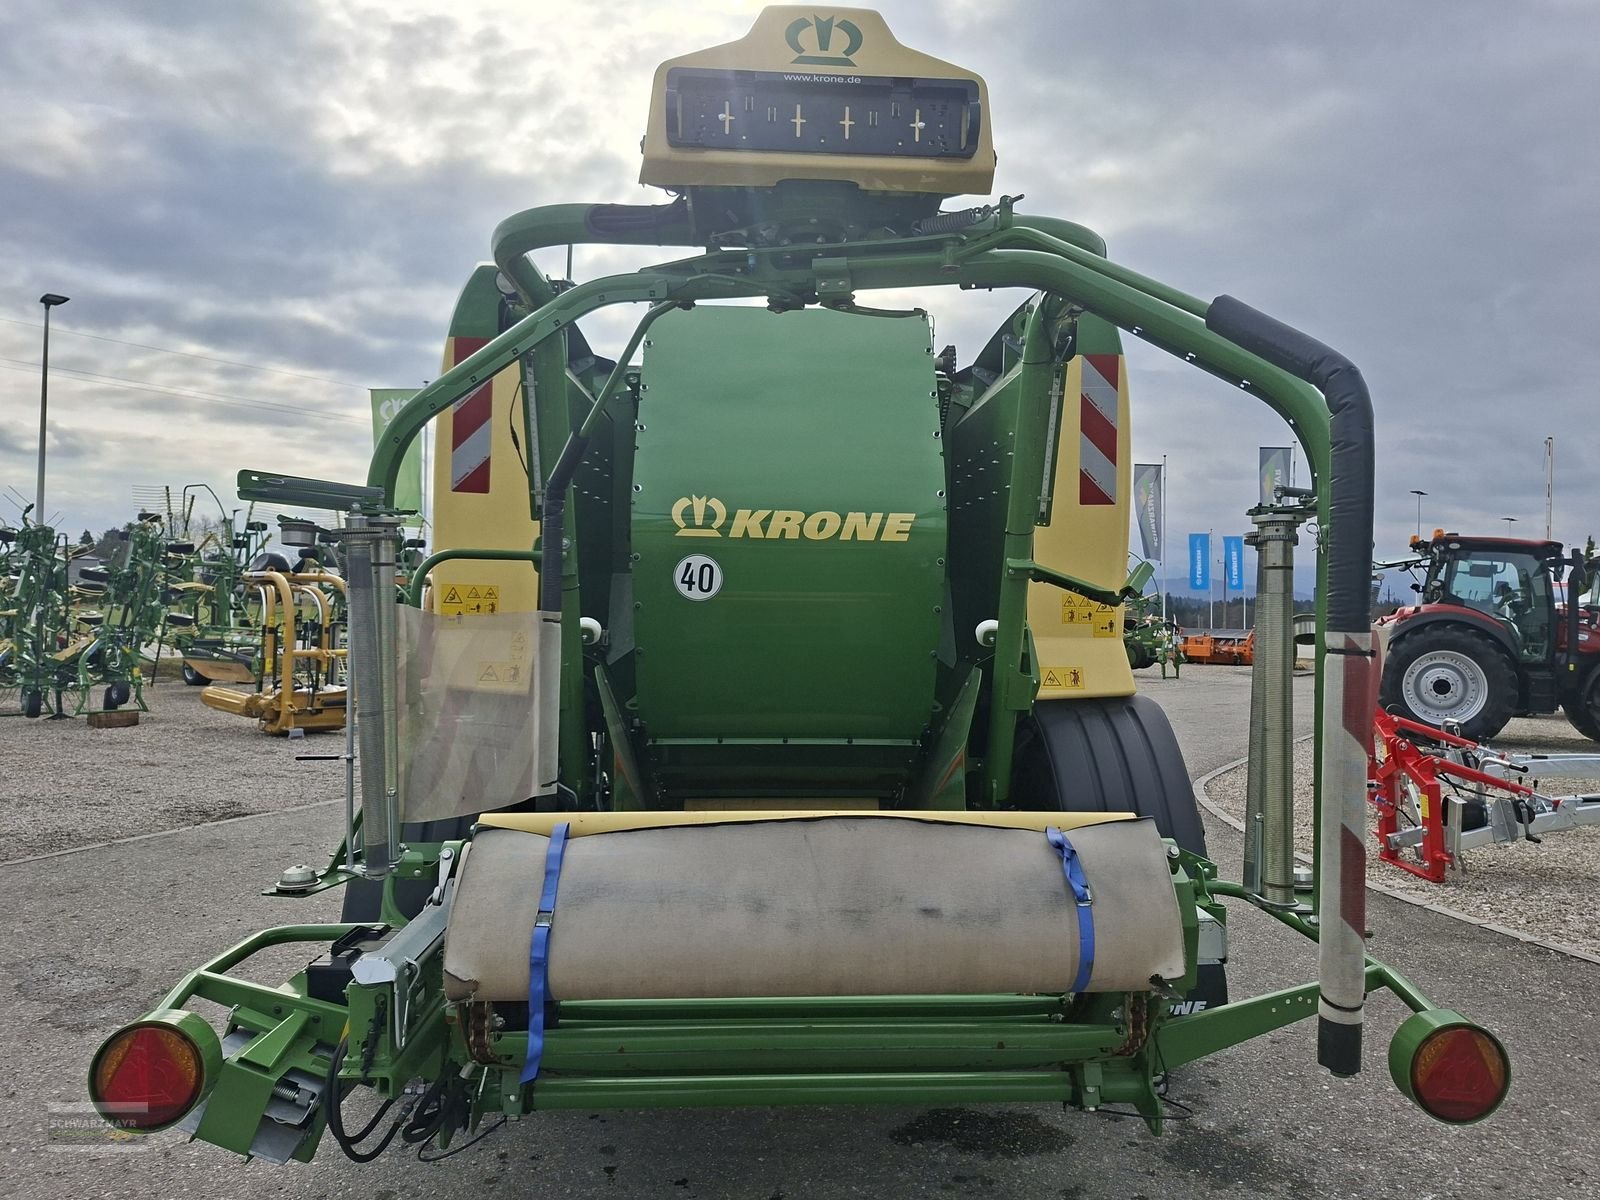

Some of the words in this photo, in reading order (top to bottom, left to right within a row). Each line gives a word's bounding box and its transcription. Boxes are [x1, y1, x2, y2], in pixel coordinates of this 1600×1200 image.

[783, 74, 862, 84] www.krone.de
[729, 509, 916, 542] KRONE
[680, 562, 715, 593] 40
